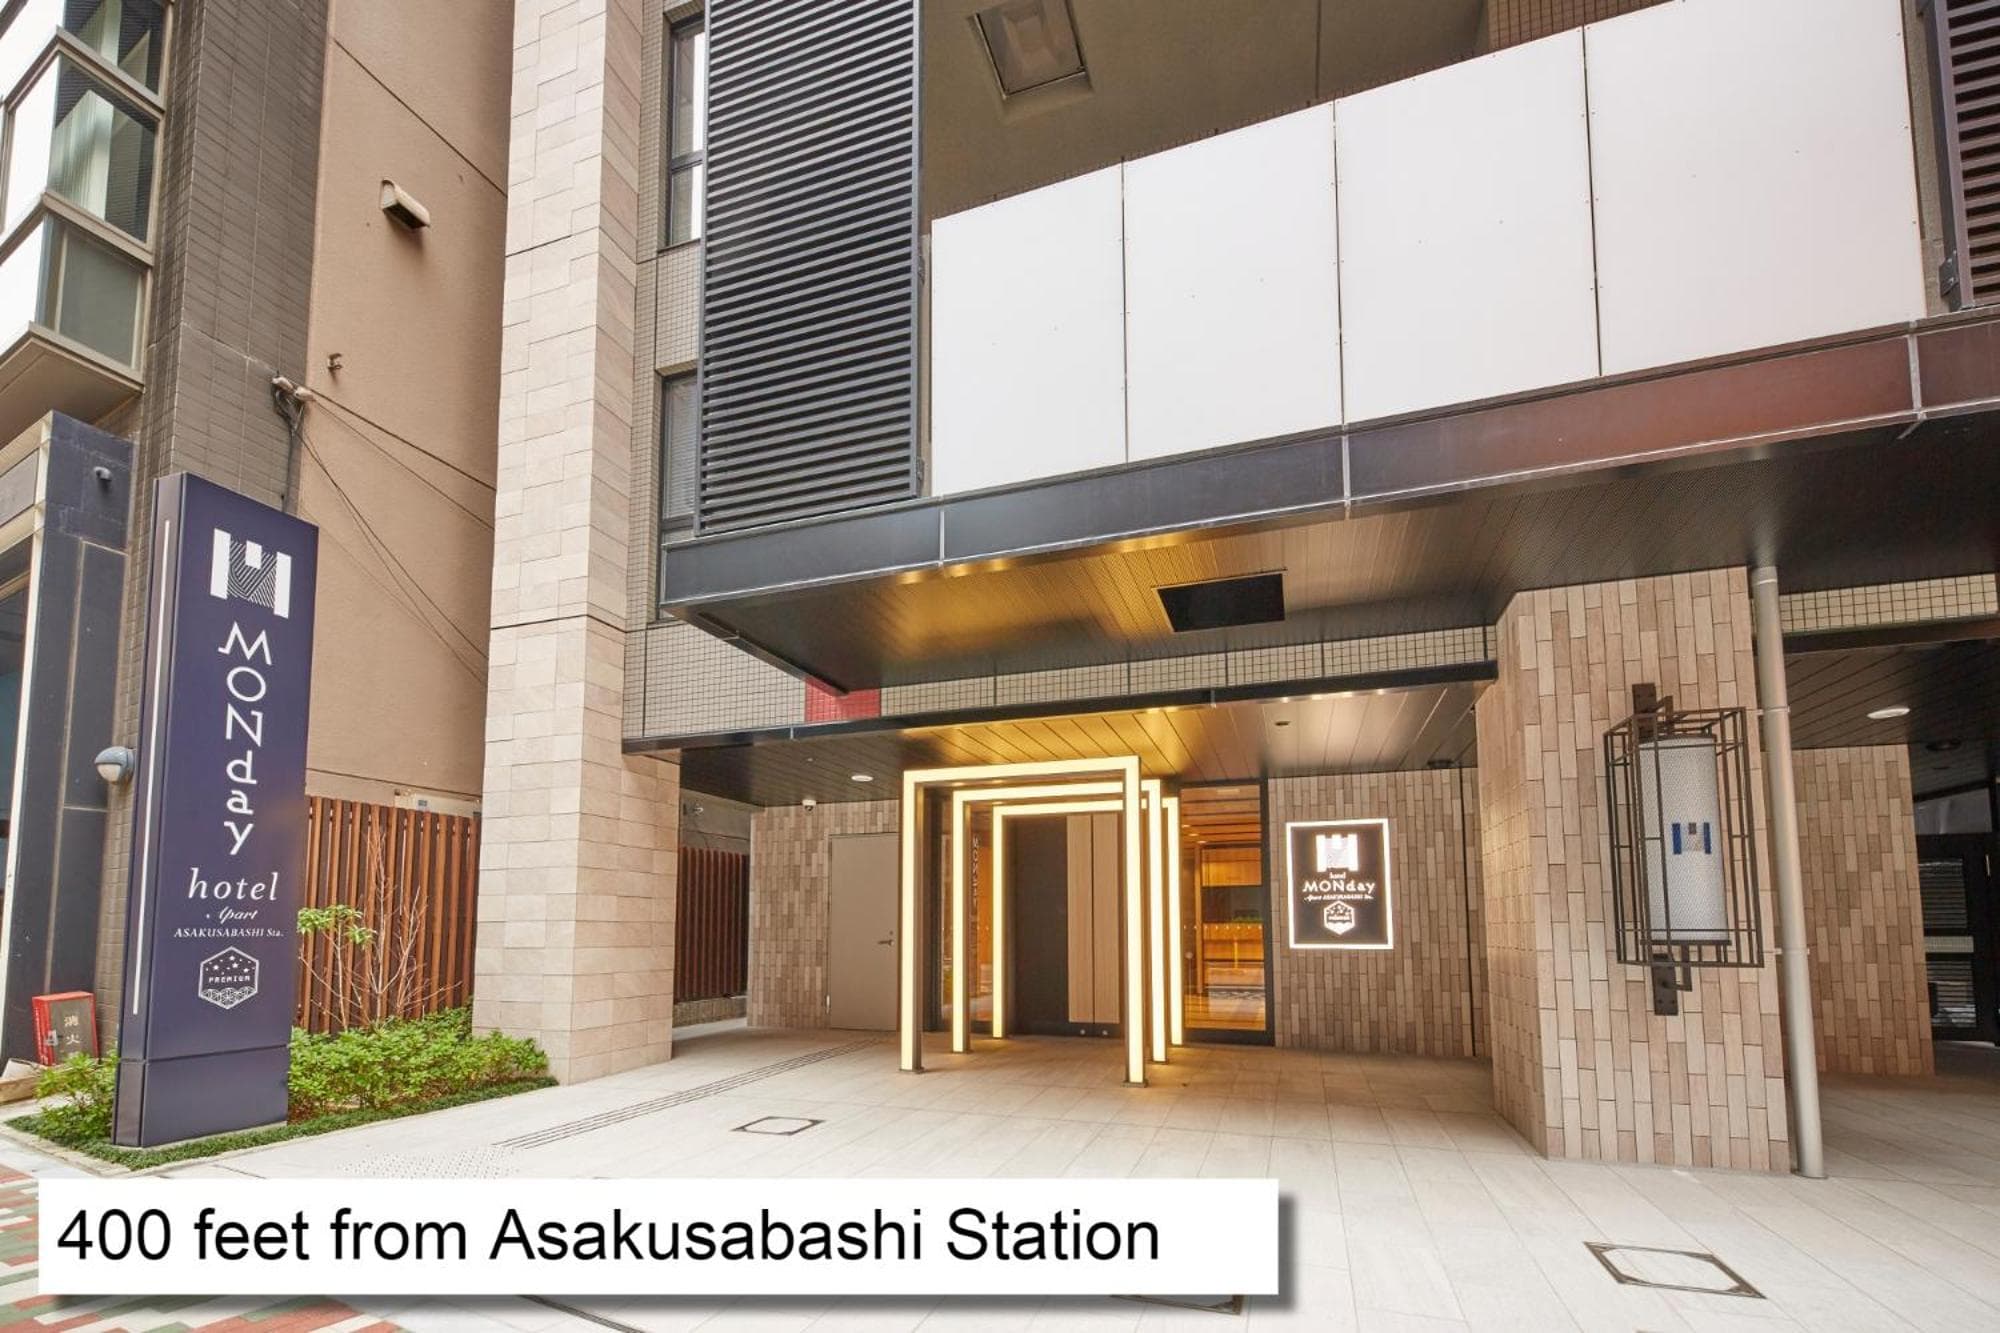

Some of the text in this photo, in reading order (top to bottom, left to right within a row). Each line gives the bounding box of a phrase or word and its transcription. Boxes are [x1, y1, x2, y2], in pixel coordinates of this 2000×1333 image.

[217, 620, 273, 856] MONday
[188, 867, 279, 901] hotel
[1302, 879, 1376, 894] MONday
[173, 927, 284, 938] ASAKUSABASHI Sta.
[208, 974, 251, 984] PREMIUM
